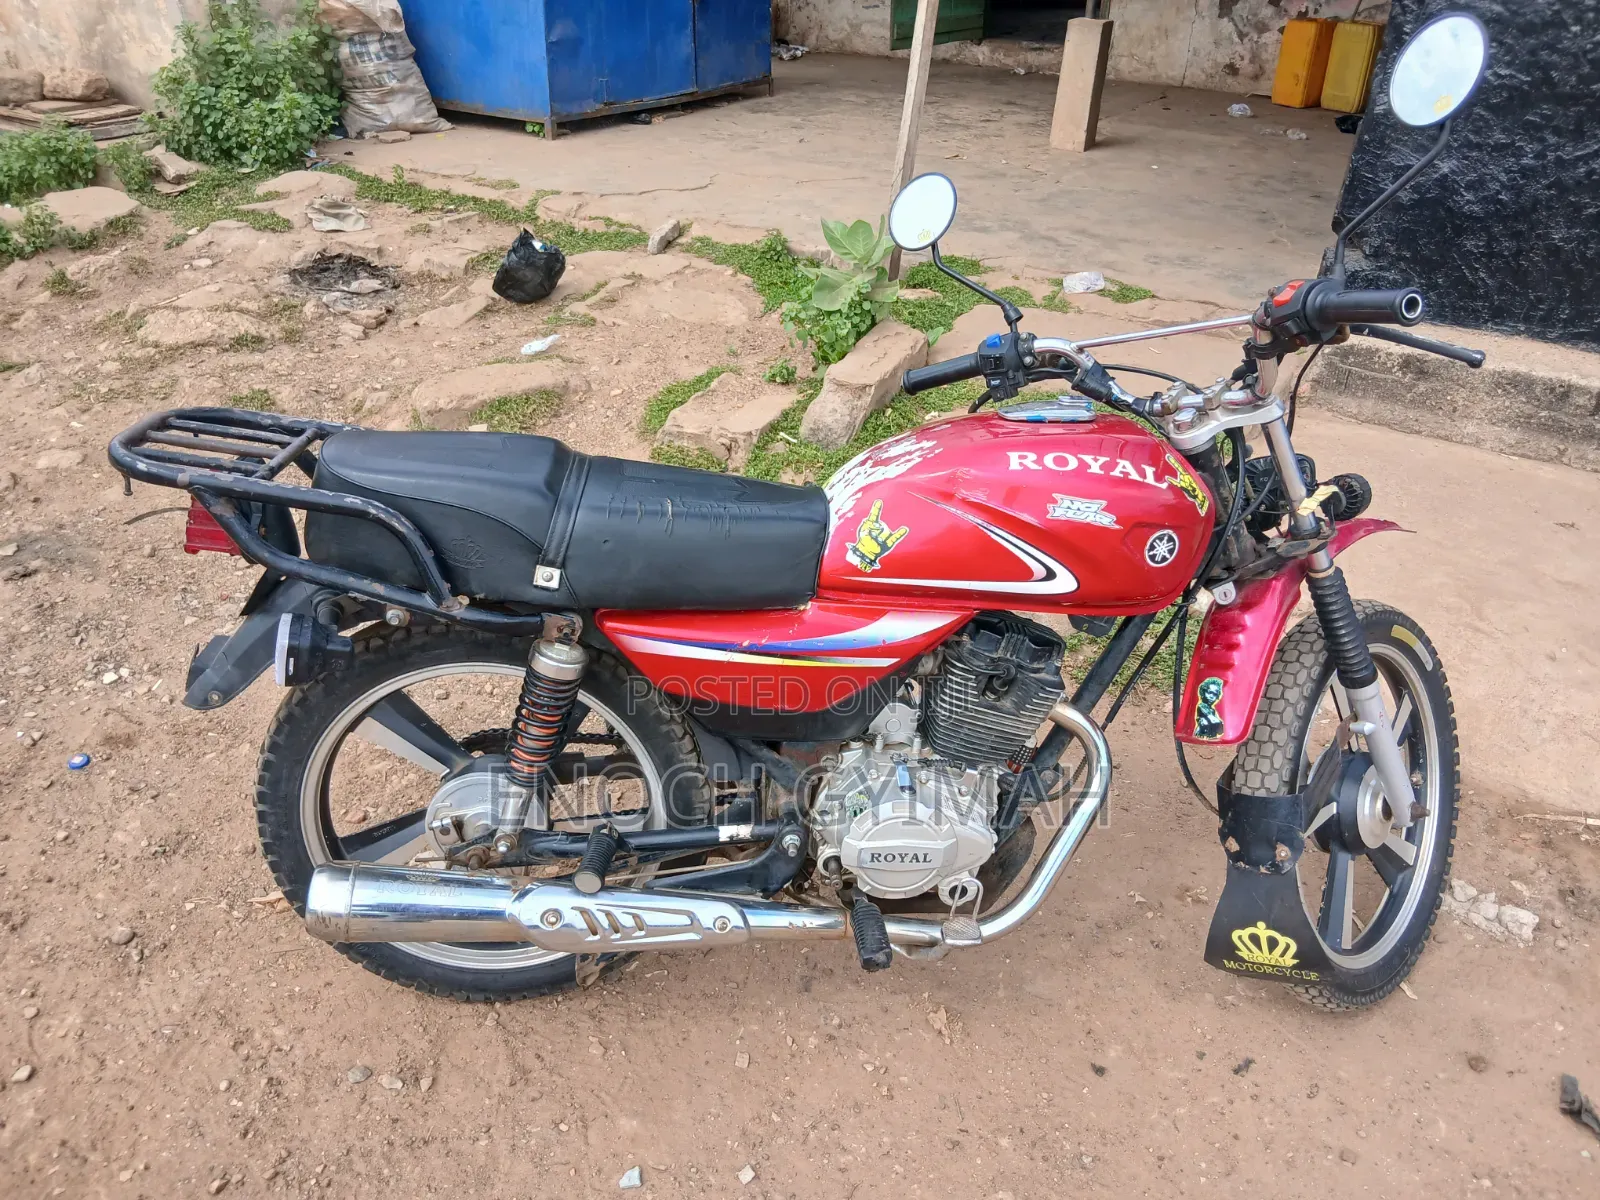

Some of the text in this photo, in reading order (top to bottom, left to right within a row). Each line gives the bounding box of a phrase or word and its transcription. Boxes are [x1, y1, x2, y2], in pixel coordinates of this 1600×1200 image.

[1006, 451, 1169, 489] ROYAL
[868, 852, 933, 864] ROYAL
[377, 879, 464, 898] ROYAL
[1246, 953, 1292, 966] ROYAL
[1222, 959, 1320, 982] MOTORCYCLE
